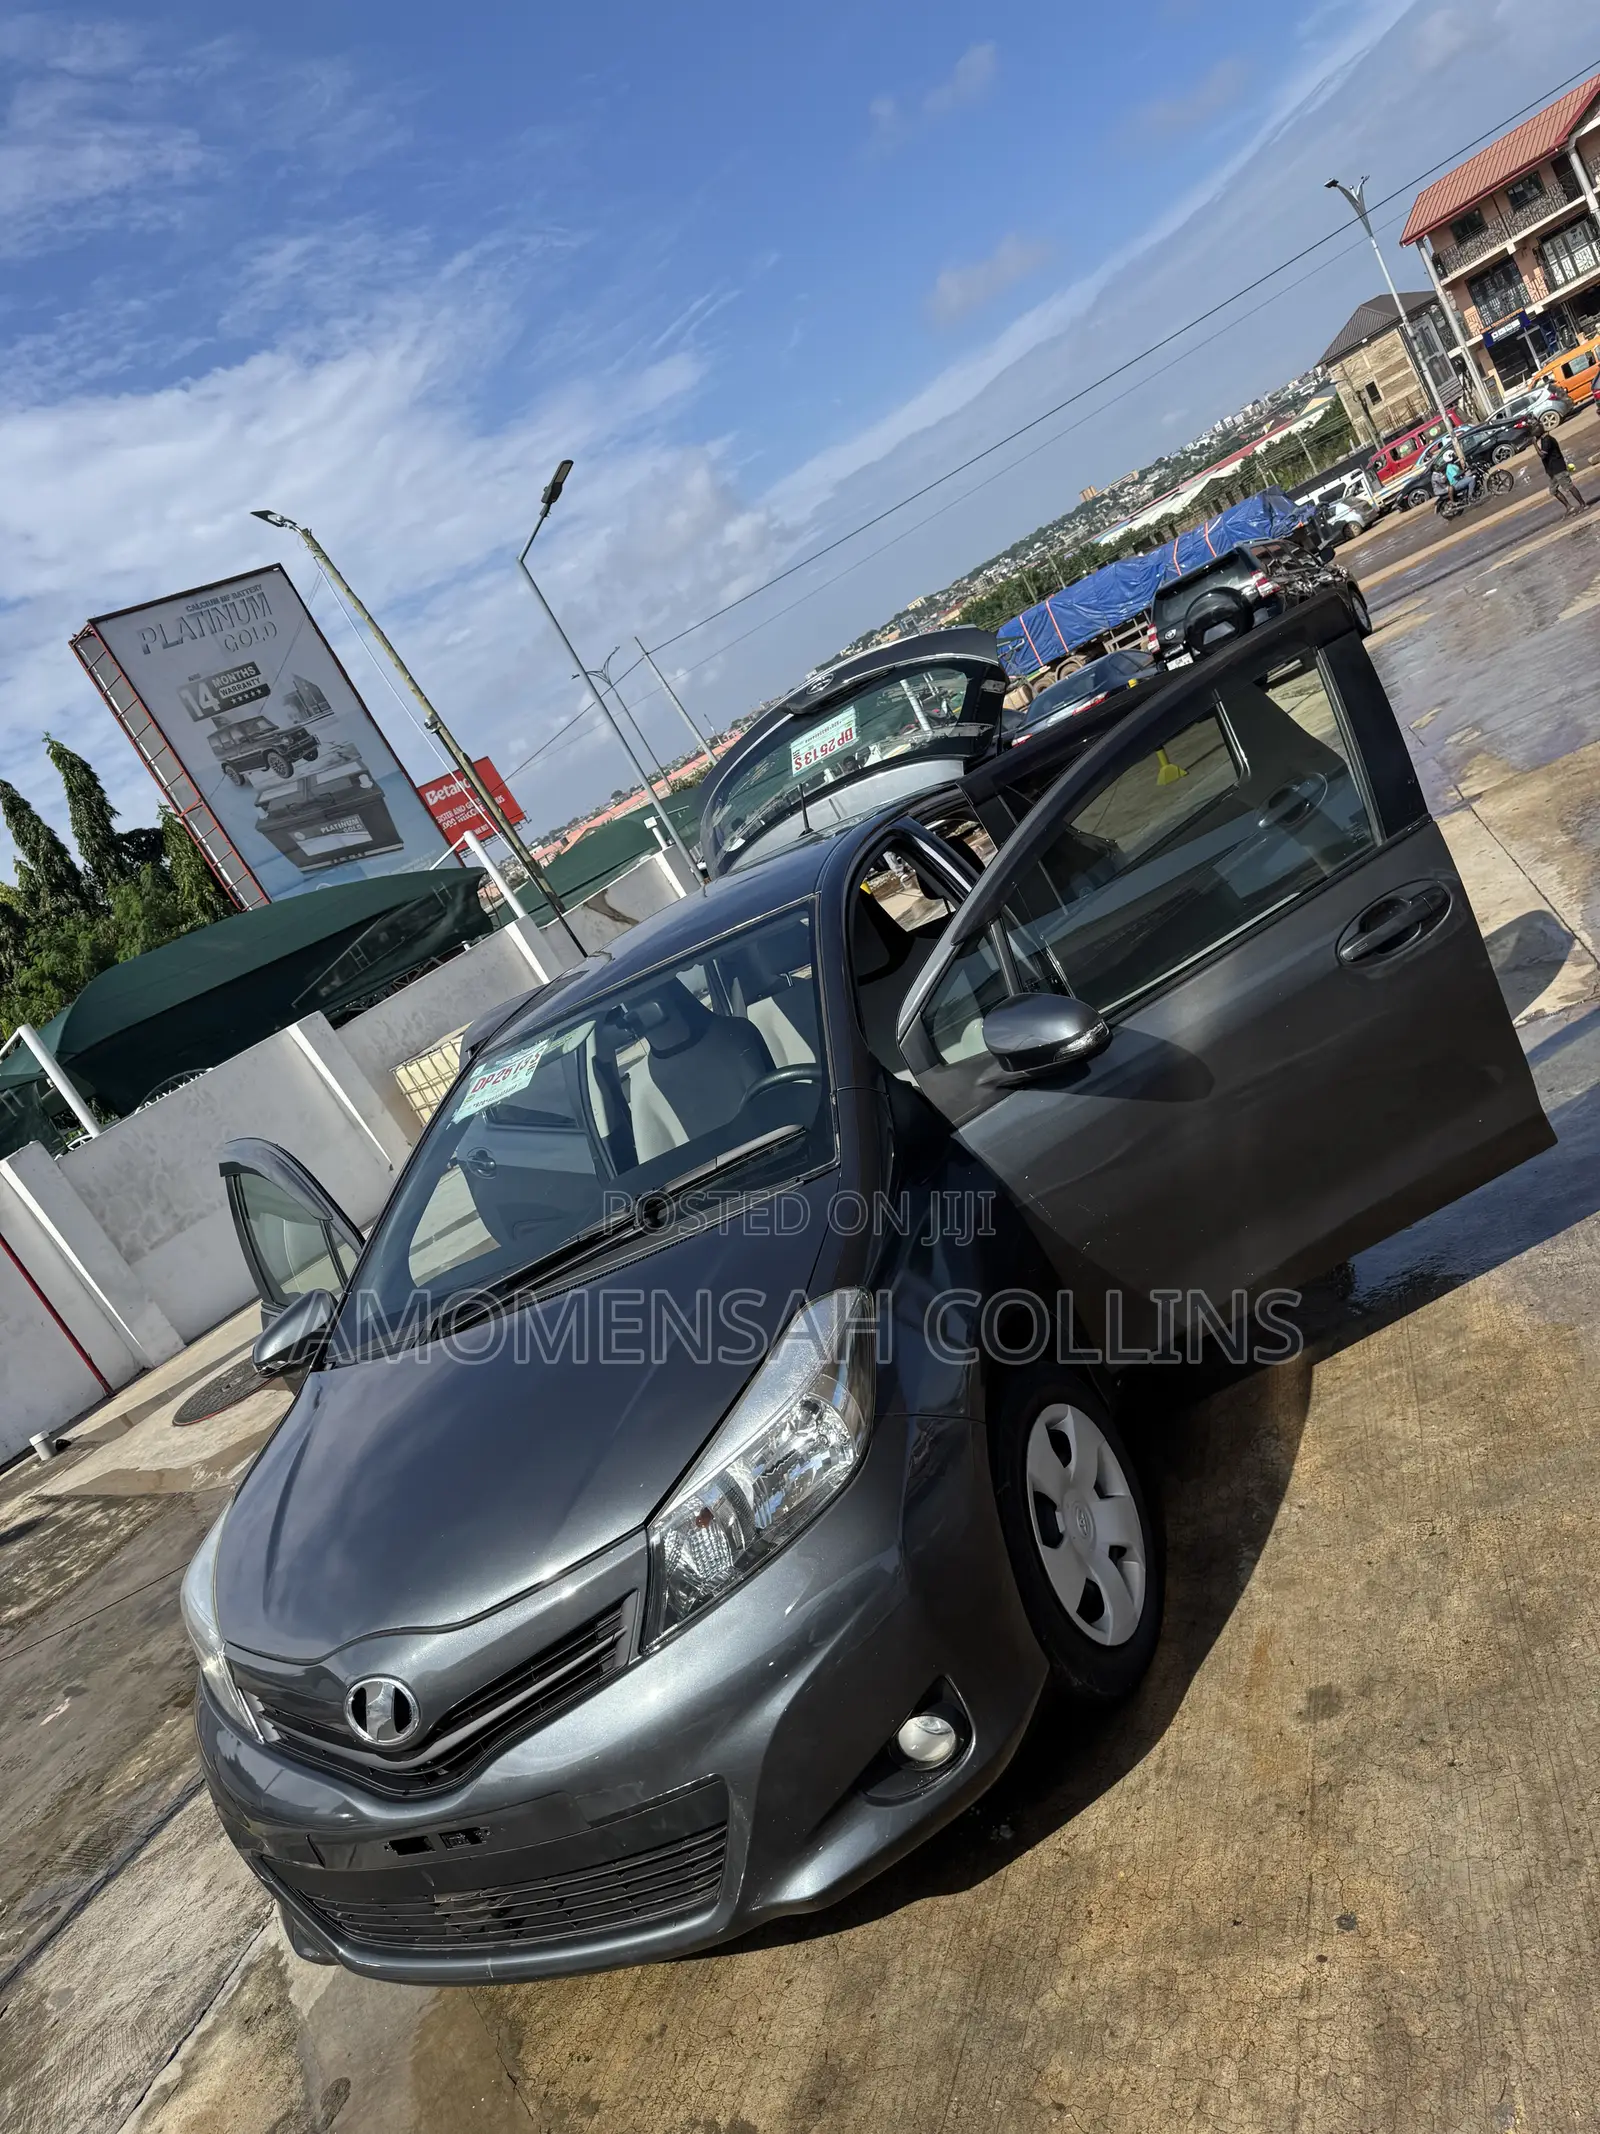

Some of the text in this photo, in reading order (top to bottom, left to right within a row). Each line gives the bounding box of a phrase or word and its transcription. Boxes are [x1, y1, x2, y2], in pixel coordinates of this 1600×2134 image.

[185, 597, 219, 613] CALCIUM
[232, 583, 263, 599] BATTERY
[136, 591, 273, 655] PLATINUM
[224, 621, 277, 653] GOLD
[211, 665, 256, 688] MONTHS
[220, 677, 261, 697] WARRANTY
[178, 681, 221, 718] 14
[320, 818, 360, 834] PLATINUM
[343, 824, 363, 834] GOLD
